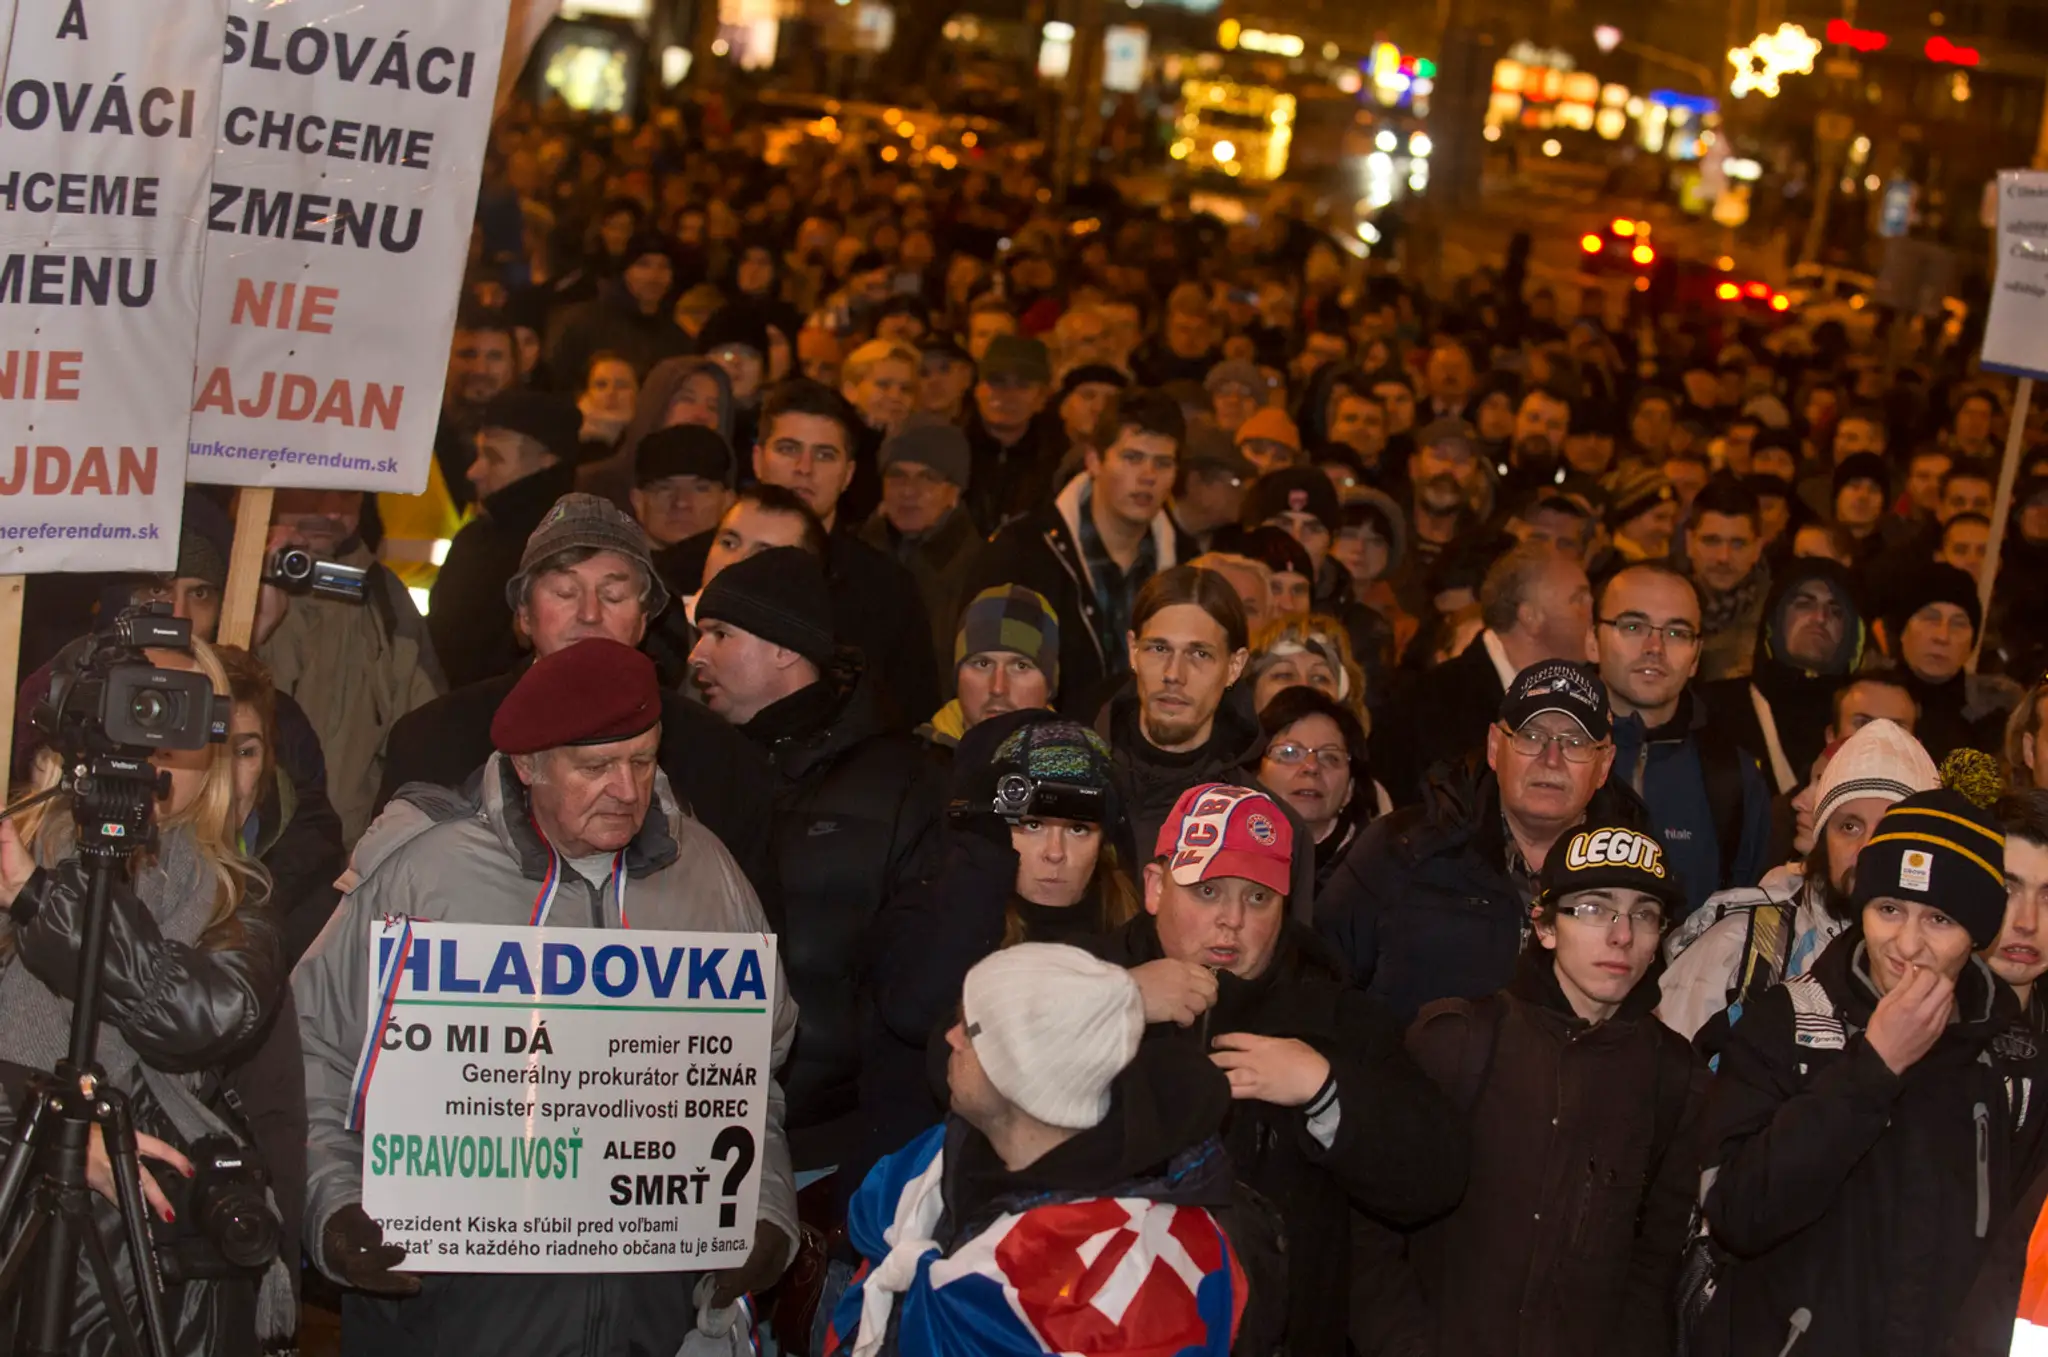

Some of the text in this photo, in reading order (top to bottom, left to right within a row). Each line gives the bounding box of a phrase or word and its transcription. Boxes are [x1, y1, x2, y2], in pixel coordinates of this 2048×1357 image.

[223, 15, 475, 98] SLOVÁCI
[0, 72, 195, 138] OVÁCI
[225, 107, 434, 169] CHCEME
[207, 183, 423, 253] ZMENU
[230, 278, 338, 334] NIE
[193, 365, 404, 430] AJDAN
[1567, 828, 1665, 877] LEGIT.
[378, 936, 767, 1001] HLADOVKA
[379, 1015, 553, 1054] ČO MI DÁ
[608, 1034, 732, 1055] premier FICO
[463, 1064, 757, 1089] Generálny prokurátor ČIŽNÁR
[446, 1097, 748, 1121] minister spravodlivosti BOREC
[215, 1160, 242, 1168] Canon
[372, 1127, 583, 1179] SPRAVODLIVOSŤ
[604, 1141, 675, 1159] ALEBO
[610, 1167, 710, 1205] SMRŤ
[710, 1125, 756, 1228] ?
[439, 1243, 458, 1254] sa
[466, 1240, 540, 1255] každého
[547, 1240, 618, 1255] riadneho
[623, 1240, 675, 1255] občana
[680, 1240, 692, 1253] tu
[696, 1238, 707, 1257] je
[711, 1238, 747, 1252] šanca.
[468, 1217, 517, 1232] Kiska
[524, 1217, 571, 1233] sľúbil
[578, 1218, 613, 1236] pred
[619, 1217, 678, 1232] voľbami
